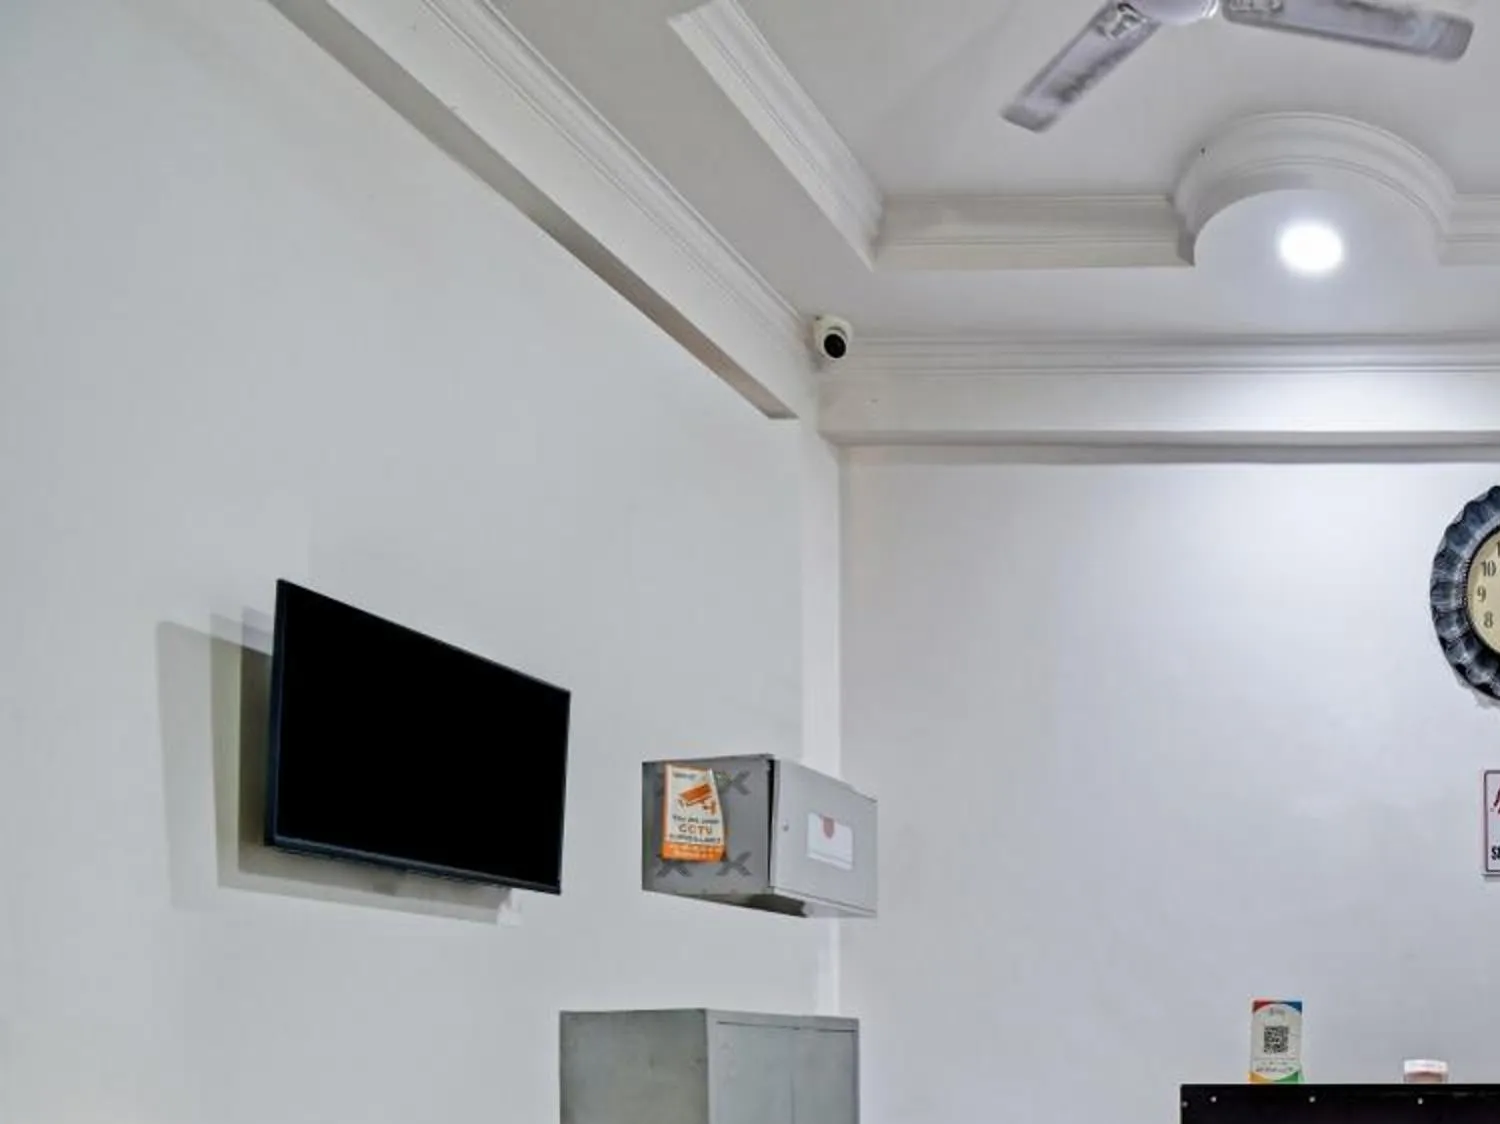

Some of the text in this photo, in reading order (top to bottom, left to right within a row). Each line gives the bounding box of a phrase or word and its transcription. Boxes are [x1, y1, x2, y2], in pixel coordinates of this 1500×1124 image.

[1481, 560, 1497, 577] 10
[1477, 586, 1487, 603] 9
[1483, 612, 1493, 628] 8
[678, 824, 713, 835] CCTV
